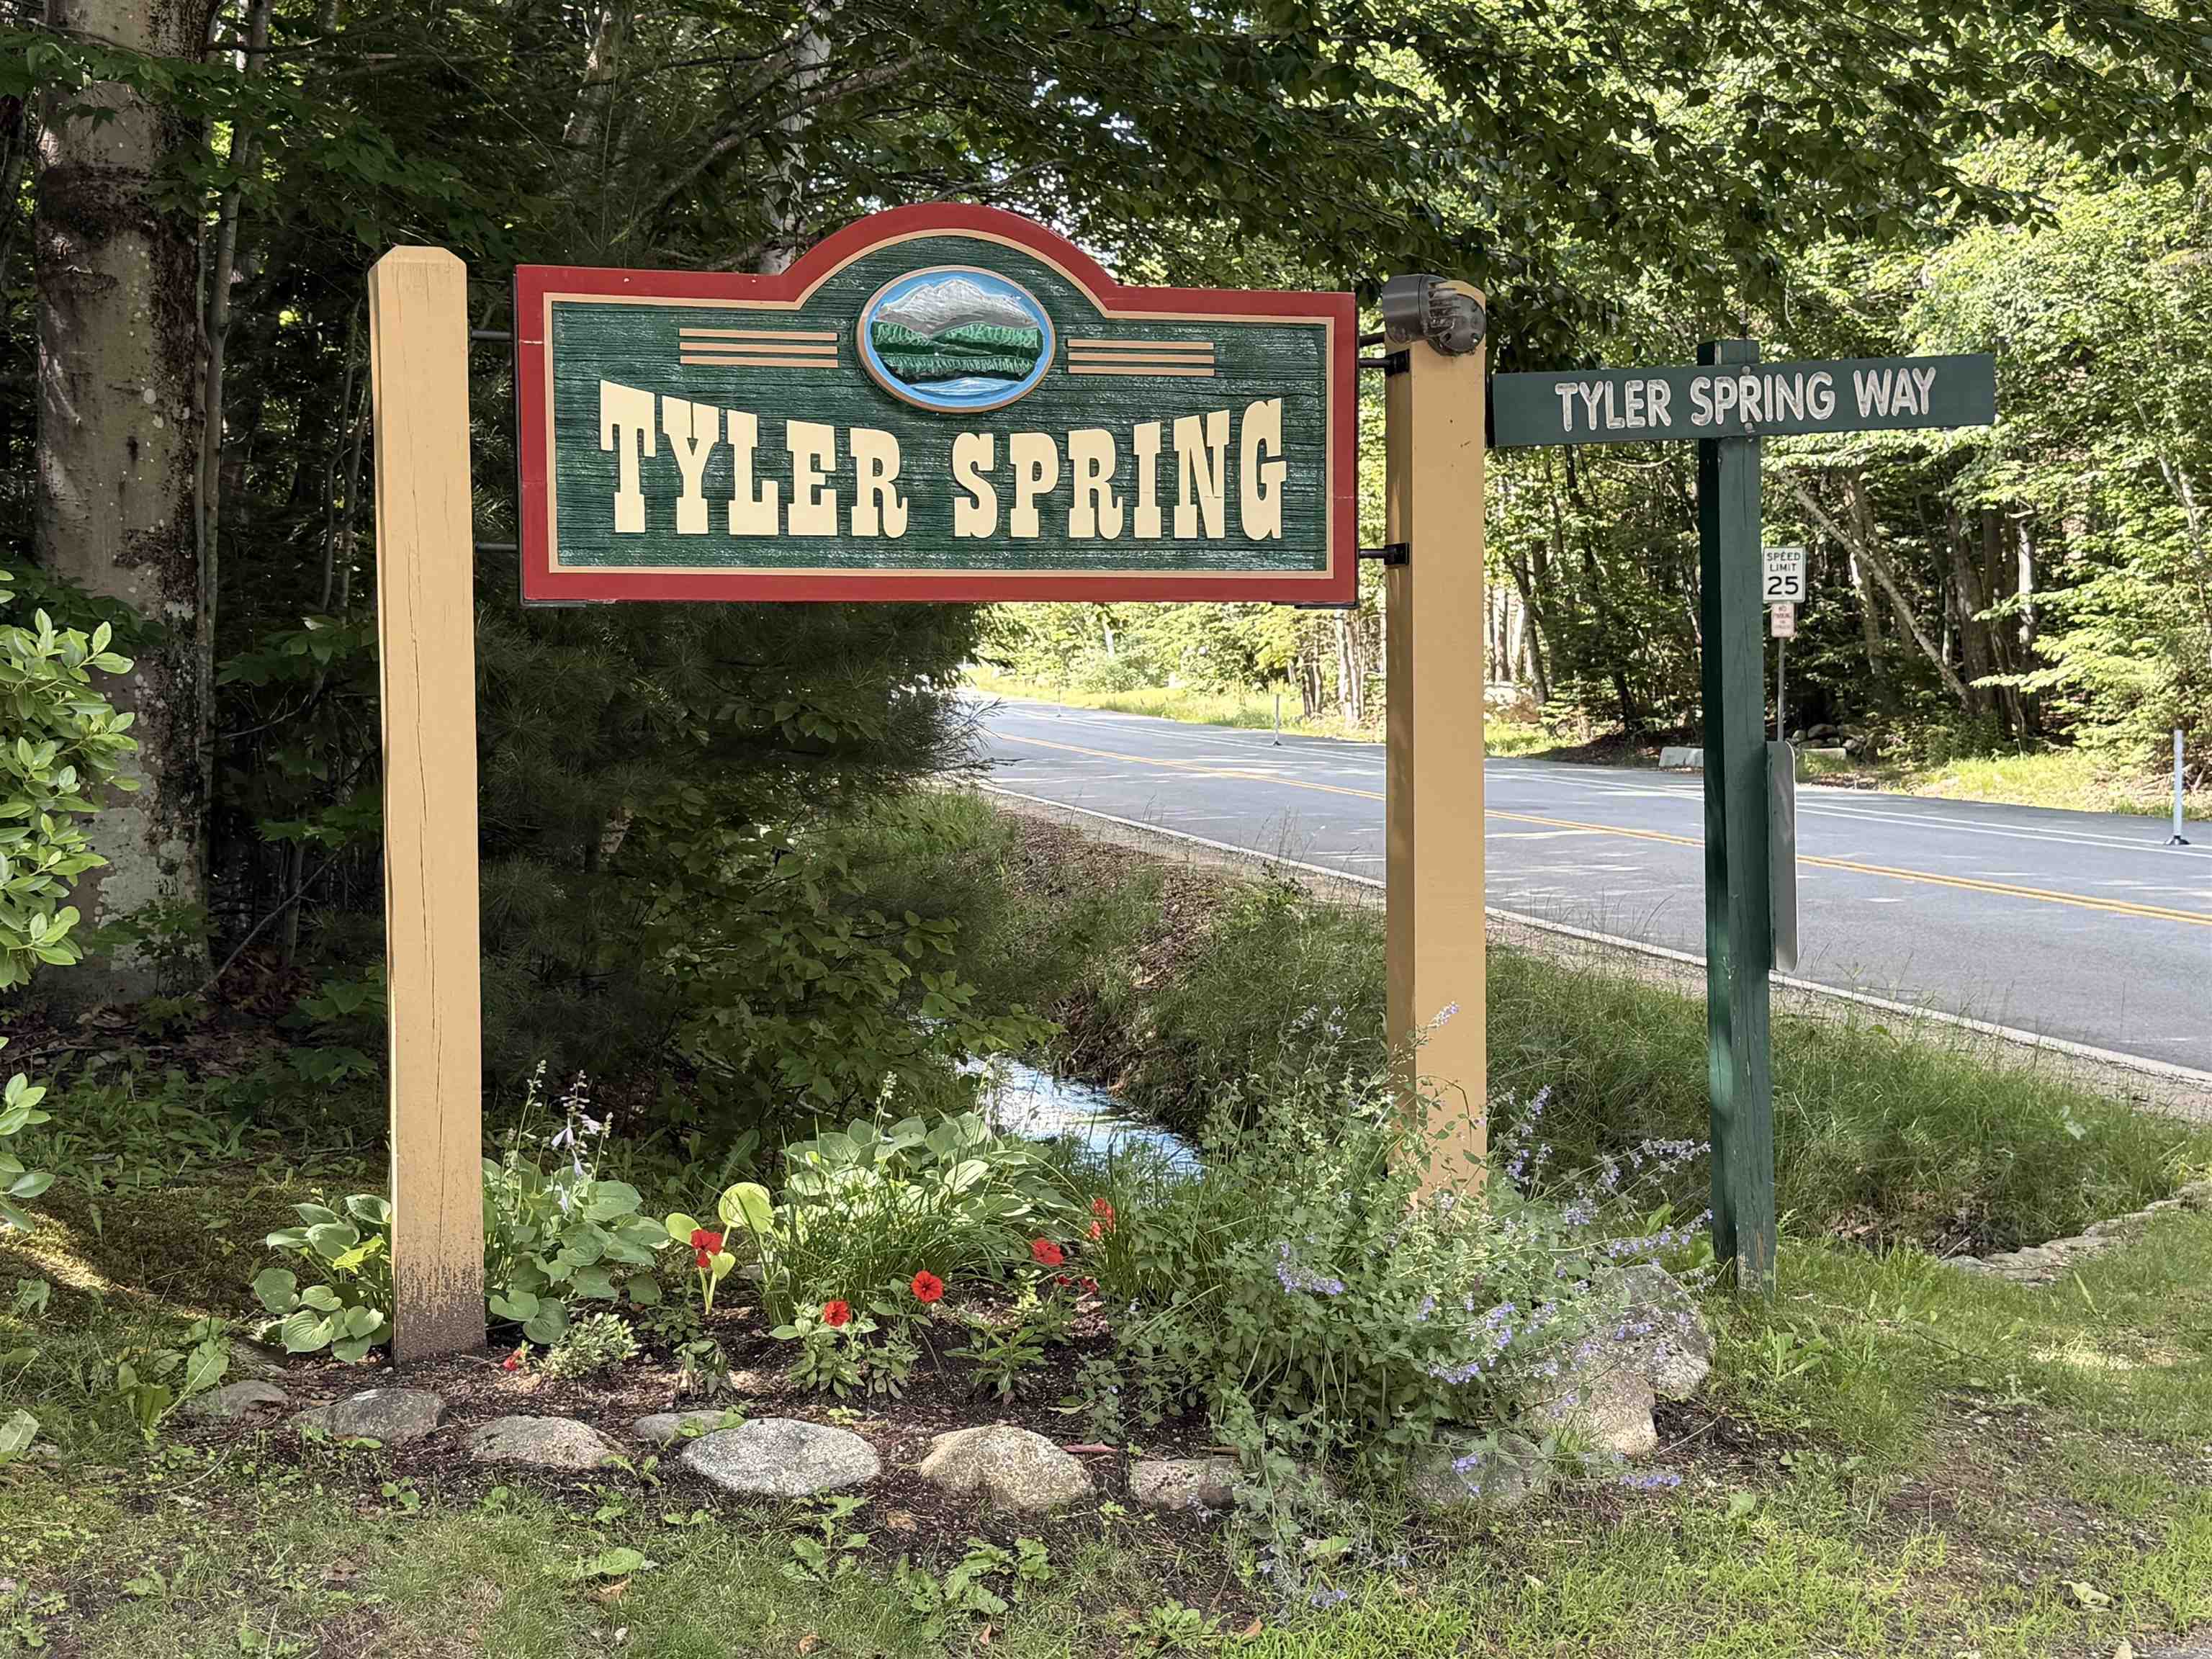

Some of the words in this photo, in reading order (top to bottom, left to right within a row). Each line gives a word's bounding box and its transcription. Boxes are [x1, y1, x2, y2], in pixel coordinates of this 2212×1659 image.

[1555, 378, 1672, 431] TYLER
[1690, 370, 1836, 427] SPRING
[1853, 366, 1936, 418] WAY
[599, 379, 909, 539] TYLER
[952, 397, 1287, 540] SPRING
[1766, 552, 1801, 561] SPEED
[1769, 563, 1797, 572] LIMIT
[1768, 575, 1799, 595] 25
